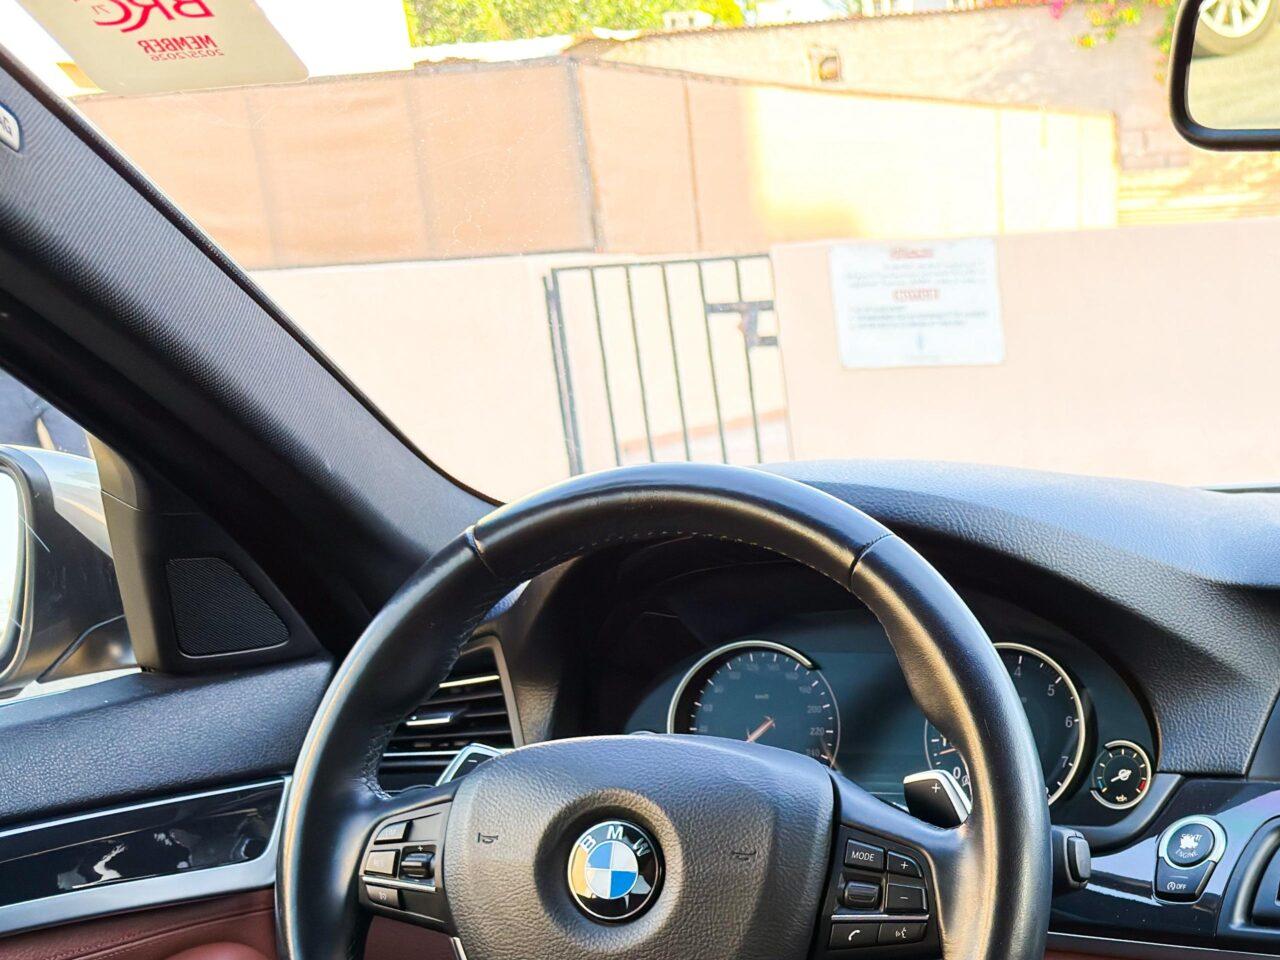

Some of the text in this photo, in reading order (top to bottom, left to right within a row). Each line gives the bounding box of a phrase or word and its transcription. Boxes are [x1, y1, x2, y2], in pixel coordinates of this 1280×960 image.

[1013, 666, 1022, 678] 4
[1047, 684, 1055, 697] 5
[1065, 716, 1073, 728] 6
[1061, 755, 1069, 768] 7
[952, 766, 961, 780] 0
[579, 825, 651, 857] BMW
[851, 850, 875, 861] MODE
